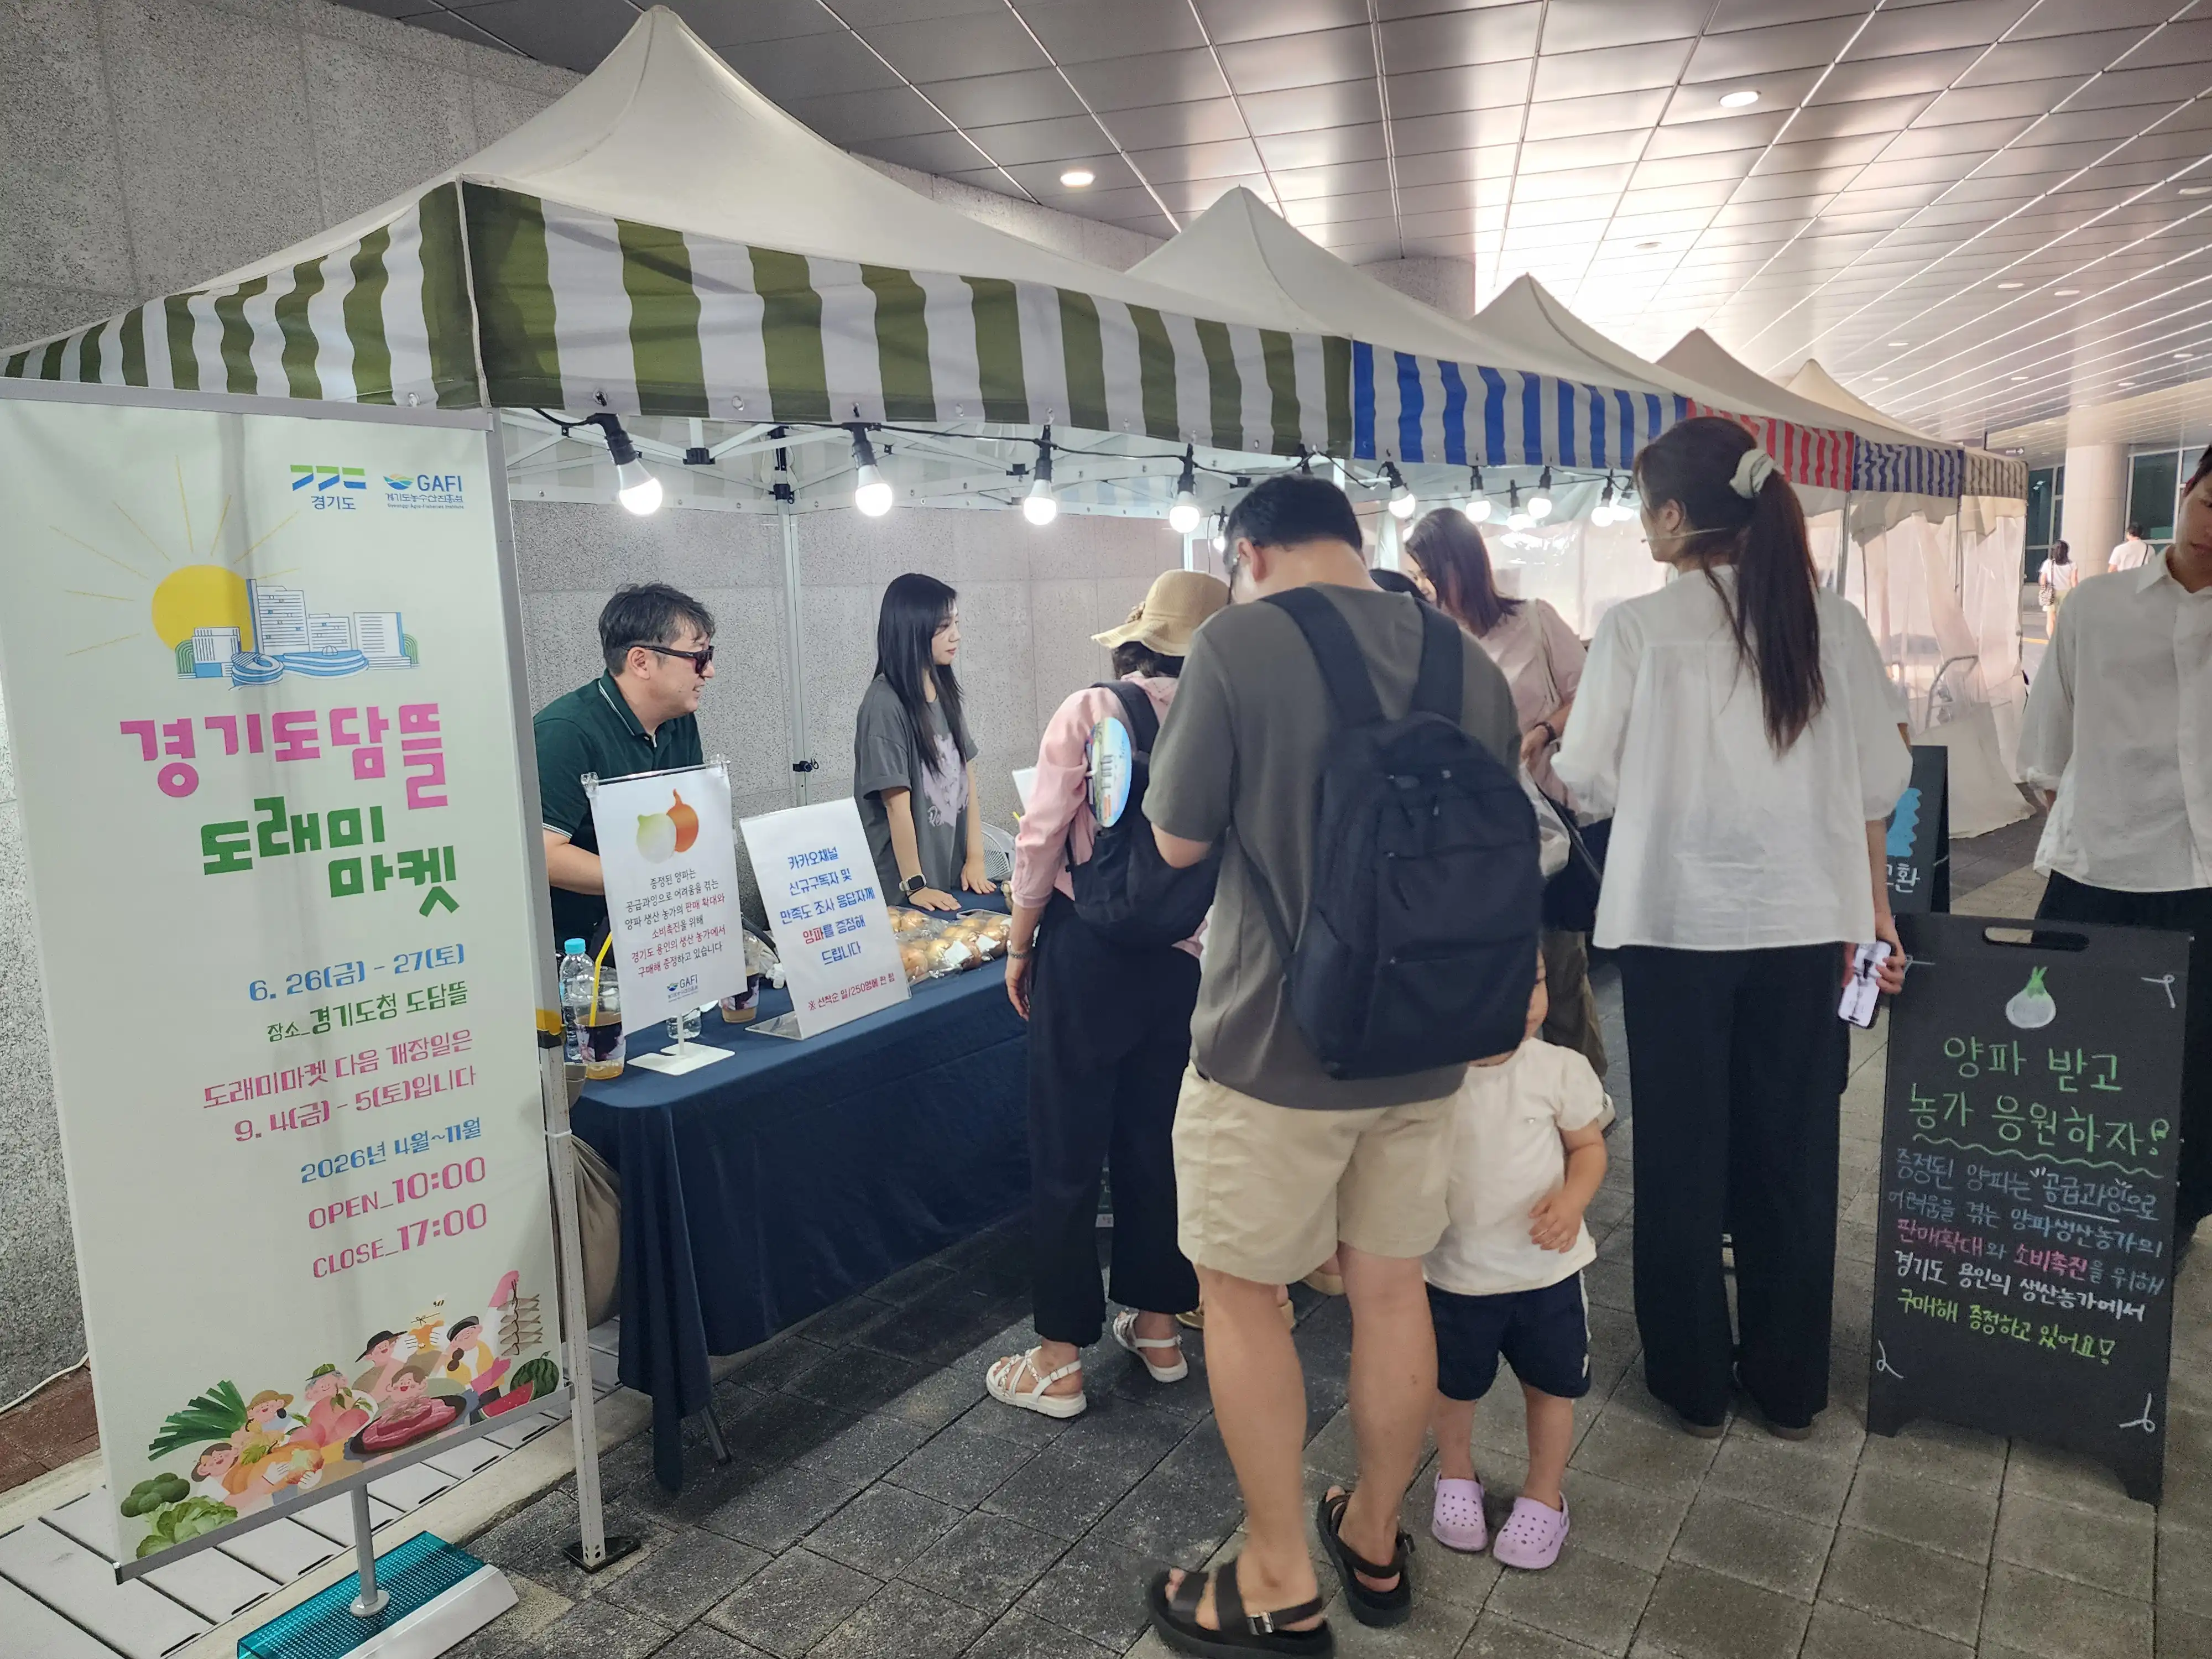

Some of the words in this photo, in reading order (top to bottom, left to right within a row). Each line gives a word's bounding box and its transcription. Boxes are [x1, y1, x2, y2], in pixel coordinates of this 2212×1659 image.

[417, 474, 462, 492] GAFI
[311, 495, 356, 510] 경기도
[120, 703, 448, 810] 경기도담뜰
[200, 796, 386, 875] 도래미
[787, 846, 839, 870] 카카오채널
[328, 845, 460, 917] 마켓
[625, 891, 672, 913] 공급과잉으로
[674, 882, 702, 899] 어려움을
[704, 879, 719, 891] 겪는
[650, 874, 673, 890] 증정된
[675, 868, 696, 883] 양파는
[790, 871, 839, 896] 신규구독자
[841, 868, 852, 882] 및
[625, 916, 641, 930] 양파
[644, 912, 660, 925] 생산
[662, 904, 684, 920] 농가의
[685, 900, 700, 912] 판매
[702, 893, 726, 908] 확대와
[780, 904, 813, 925] 만족도
[814, 898, 835, 915] 조사
[837, 886, 875, 909] 응답자께
[632, 947, 655, 963] 경기도
[656, 938, 677, 956] 용인의
[680, 934, 694, 948] 생산
[696, 924, 726, 942] 농가에서
[652, 919, 687, 939] 소비촉진을
[689, 914, 704, 927] 위해
[803, 924, 834, 945] 양파를
[835, 915, 867, 935] 증정해
[249, 980, 276, 1001] 6.
[286, 960, 366, 995] 26(금)
[394, 943, 465, 975] 27(토)
[638, 961, 661, 978] 구매해
[664, 952, 692, 970] 증정하고
[693, 941, 723, 959] 있습니다
[821, 941, 862, 966] 드립니다
[406, 980, 468, 1014] 도담뜰
[680, 974, 698, 988] GAFI
[818, 993, 839, 1008] 선착순
[204, 1060, 328, 1109] 도래미마켓
[335, 1049, 380, 1079] 다음
[386, 1029, 474, 1066] 개장일은
[1944, 1035, 2027, 1078] 양파
[2049, 1047, 2123, 1093] 받고
[234, 1120, 262, 1142] 9.
[269, 1099, 331, 1133] 4(금)
[356, 1065, 477, 1112] 5(토)입니다
[1908, 1082, 1974, 1129] 농가
[301, 1140, 387, 1184] 2026년
[394, 1117, 482, 1155] 4월~11월
[1897, 1148, 1954, 1190] 증정된
[1966, 1164, 2032, 1201] 양파는
[1889, 1188, 1956, 1223] 어려움을
[1894, 1249, 1948, 1285] 경기도
[1958, 1262, 2012, 1296] 용인의
[2014, 1243, 2104, 1284] 소비촉진을
[2111, 1267, 2165, 1295] 위해
[1897, 1288, 1959, 1323] 구매해
[1969, 1304, 2031, 1343] 증정하고
